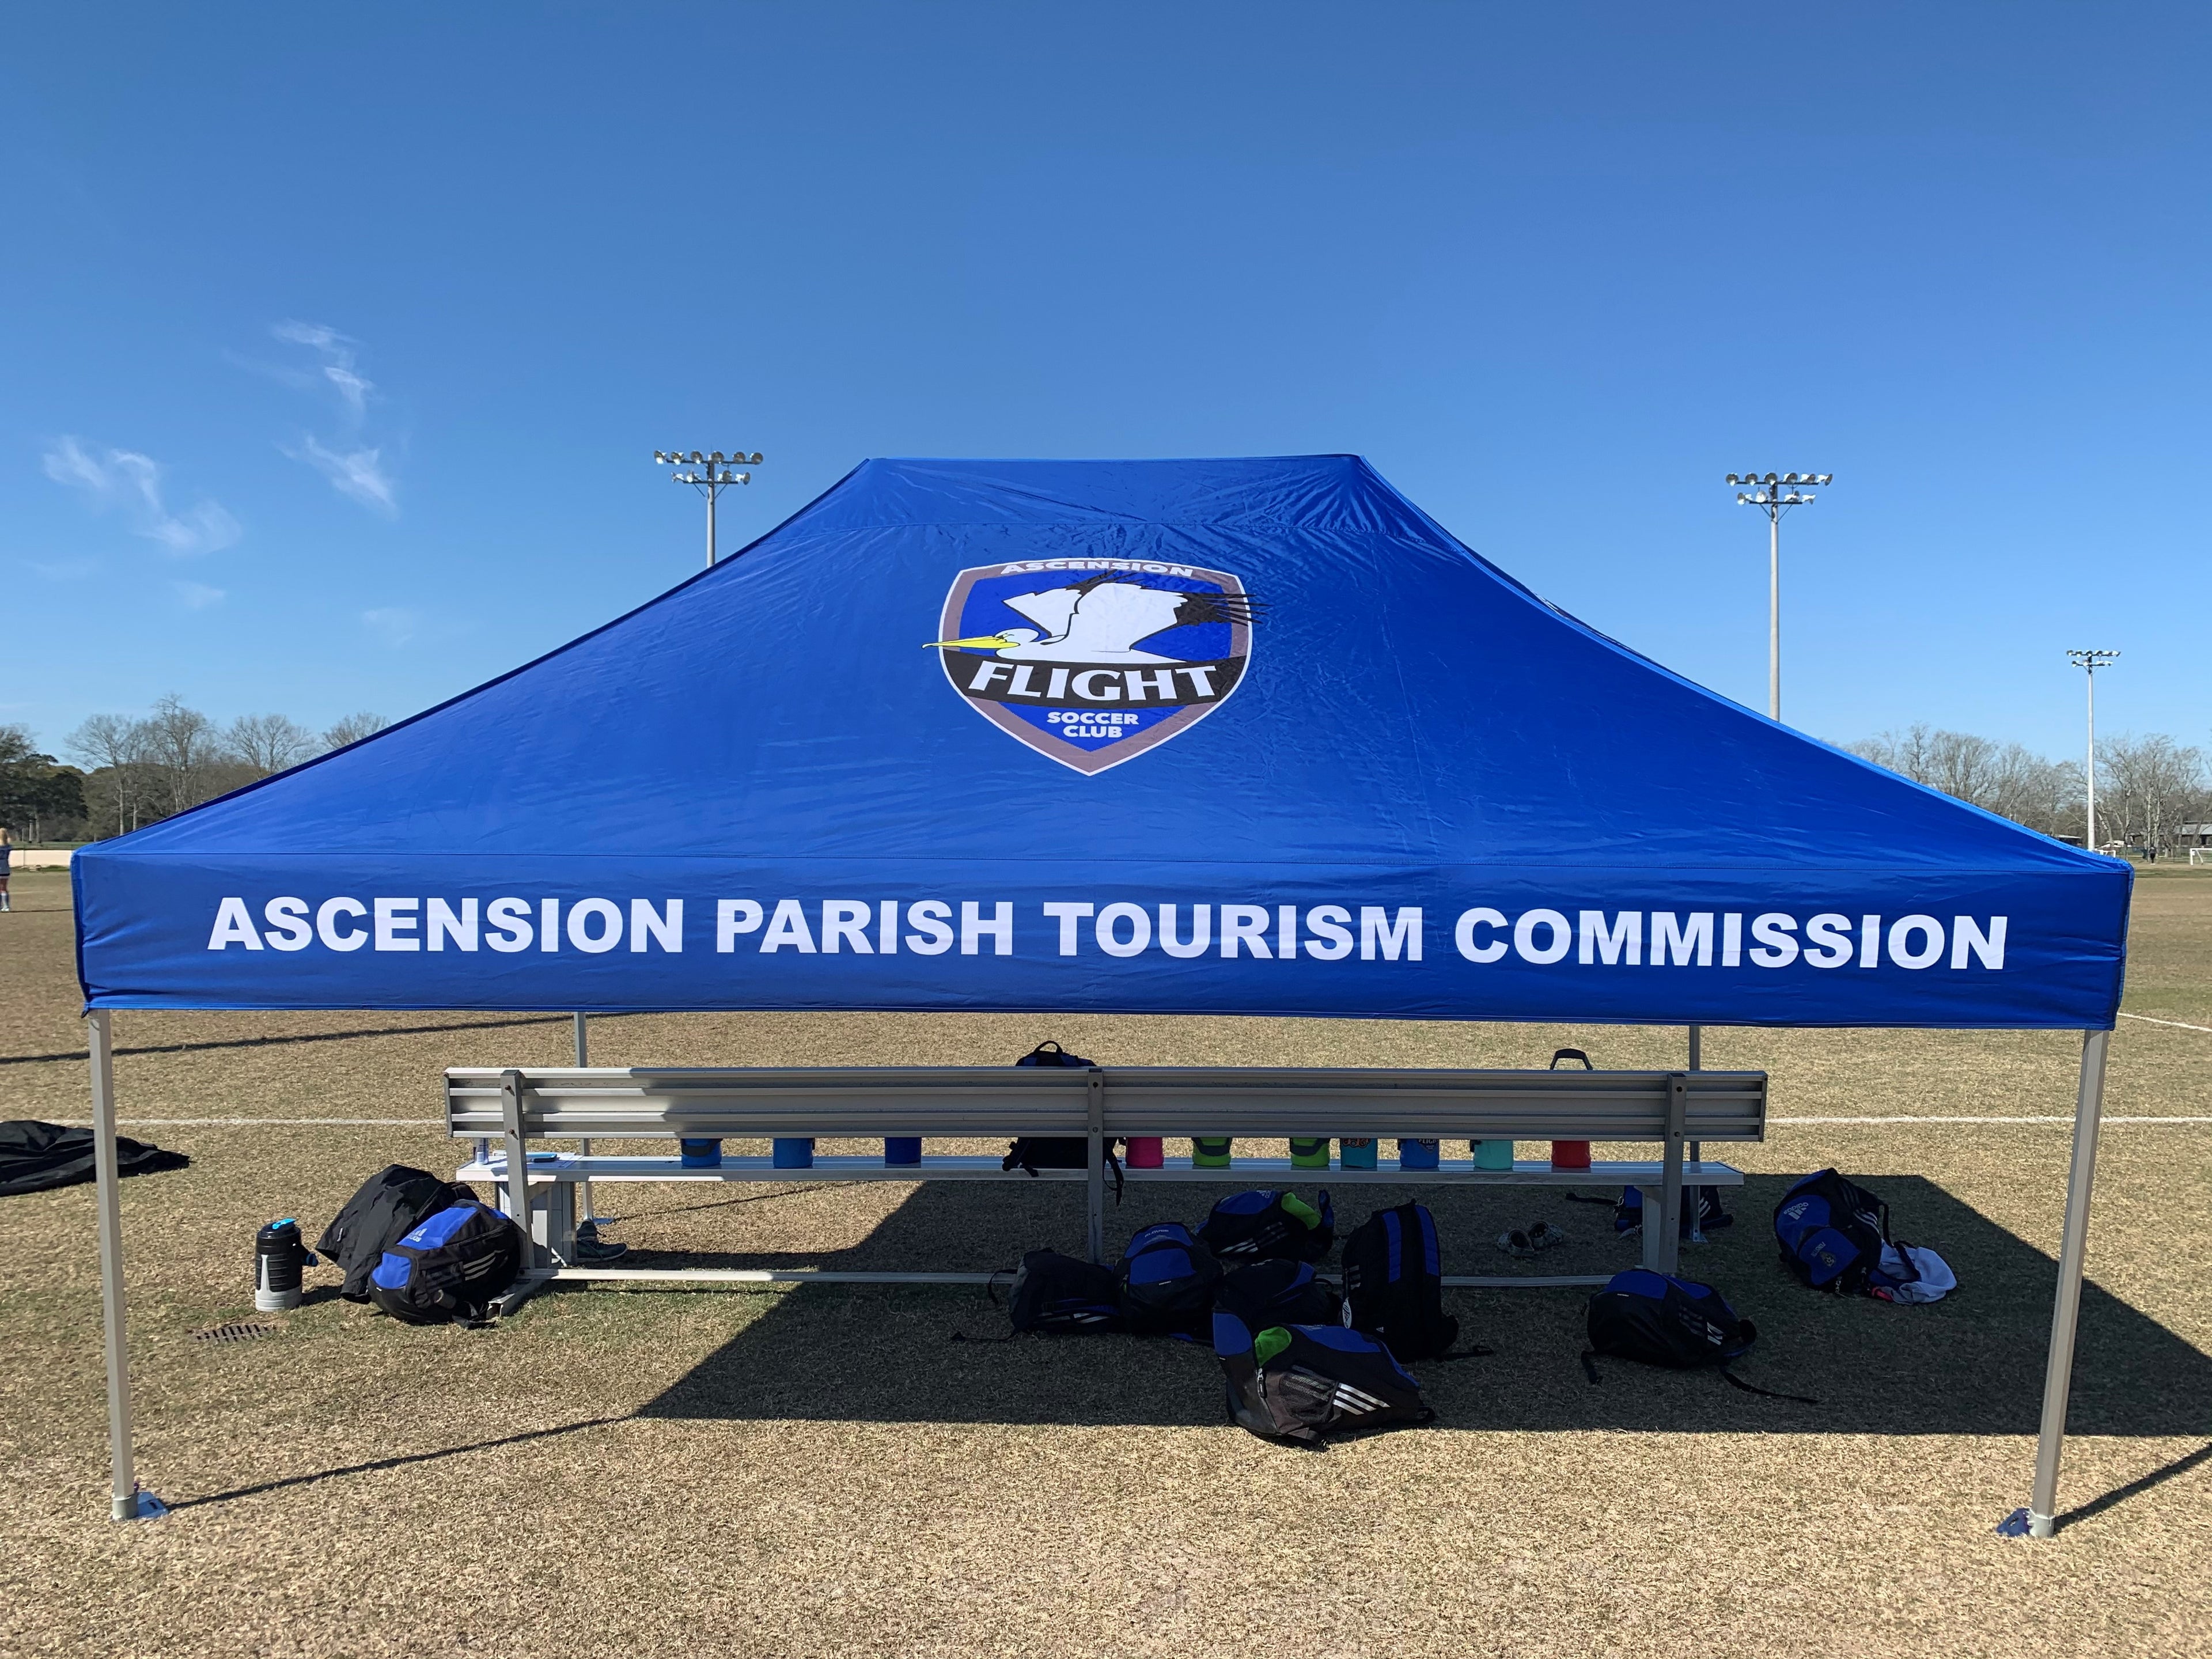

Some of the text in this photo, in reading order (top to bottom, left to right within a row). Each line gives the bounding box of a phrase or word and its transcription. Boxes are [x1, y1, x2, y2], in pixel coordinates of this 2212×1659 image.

[1000, 561, 1193, 577] ASCENSION
[968, 660, 1217, 701] FLIGHT
[1047, 712, 1139, 725] SOCCER
[1063, 725, 1123, 738] CLUB
[207, 897, 2008, 969] ASCENSION PARISH TOURISM COMMISSION
[1783, 1202, 1809, 1215] adidas
